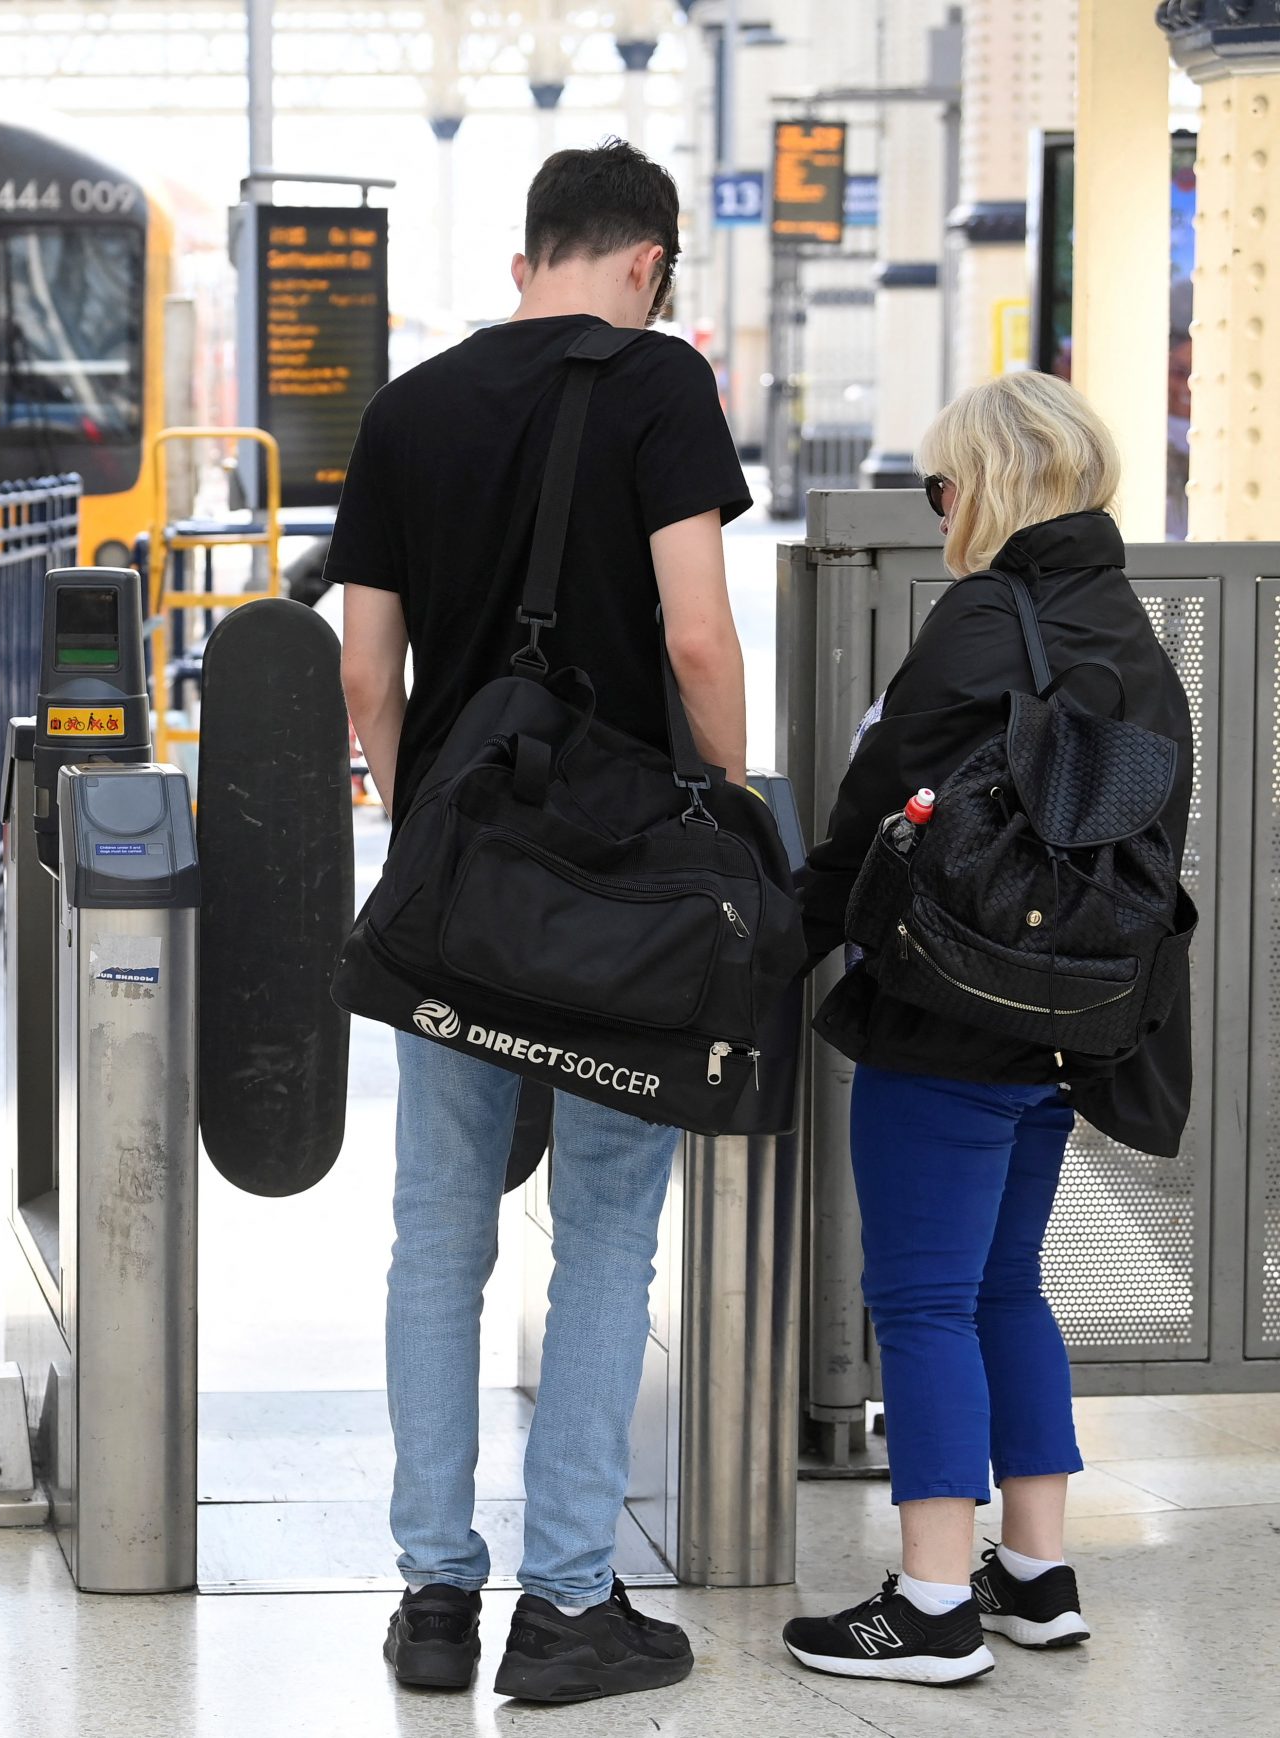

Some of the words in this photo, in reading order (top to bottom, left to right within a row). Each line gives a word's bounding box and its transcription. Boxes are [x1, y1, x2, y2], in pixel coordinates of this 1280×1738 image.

[71, 179, 136, 213] 009
[716, 181, 761, 217] 13
[115, 974, 154, 982] SHADOW
